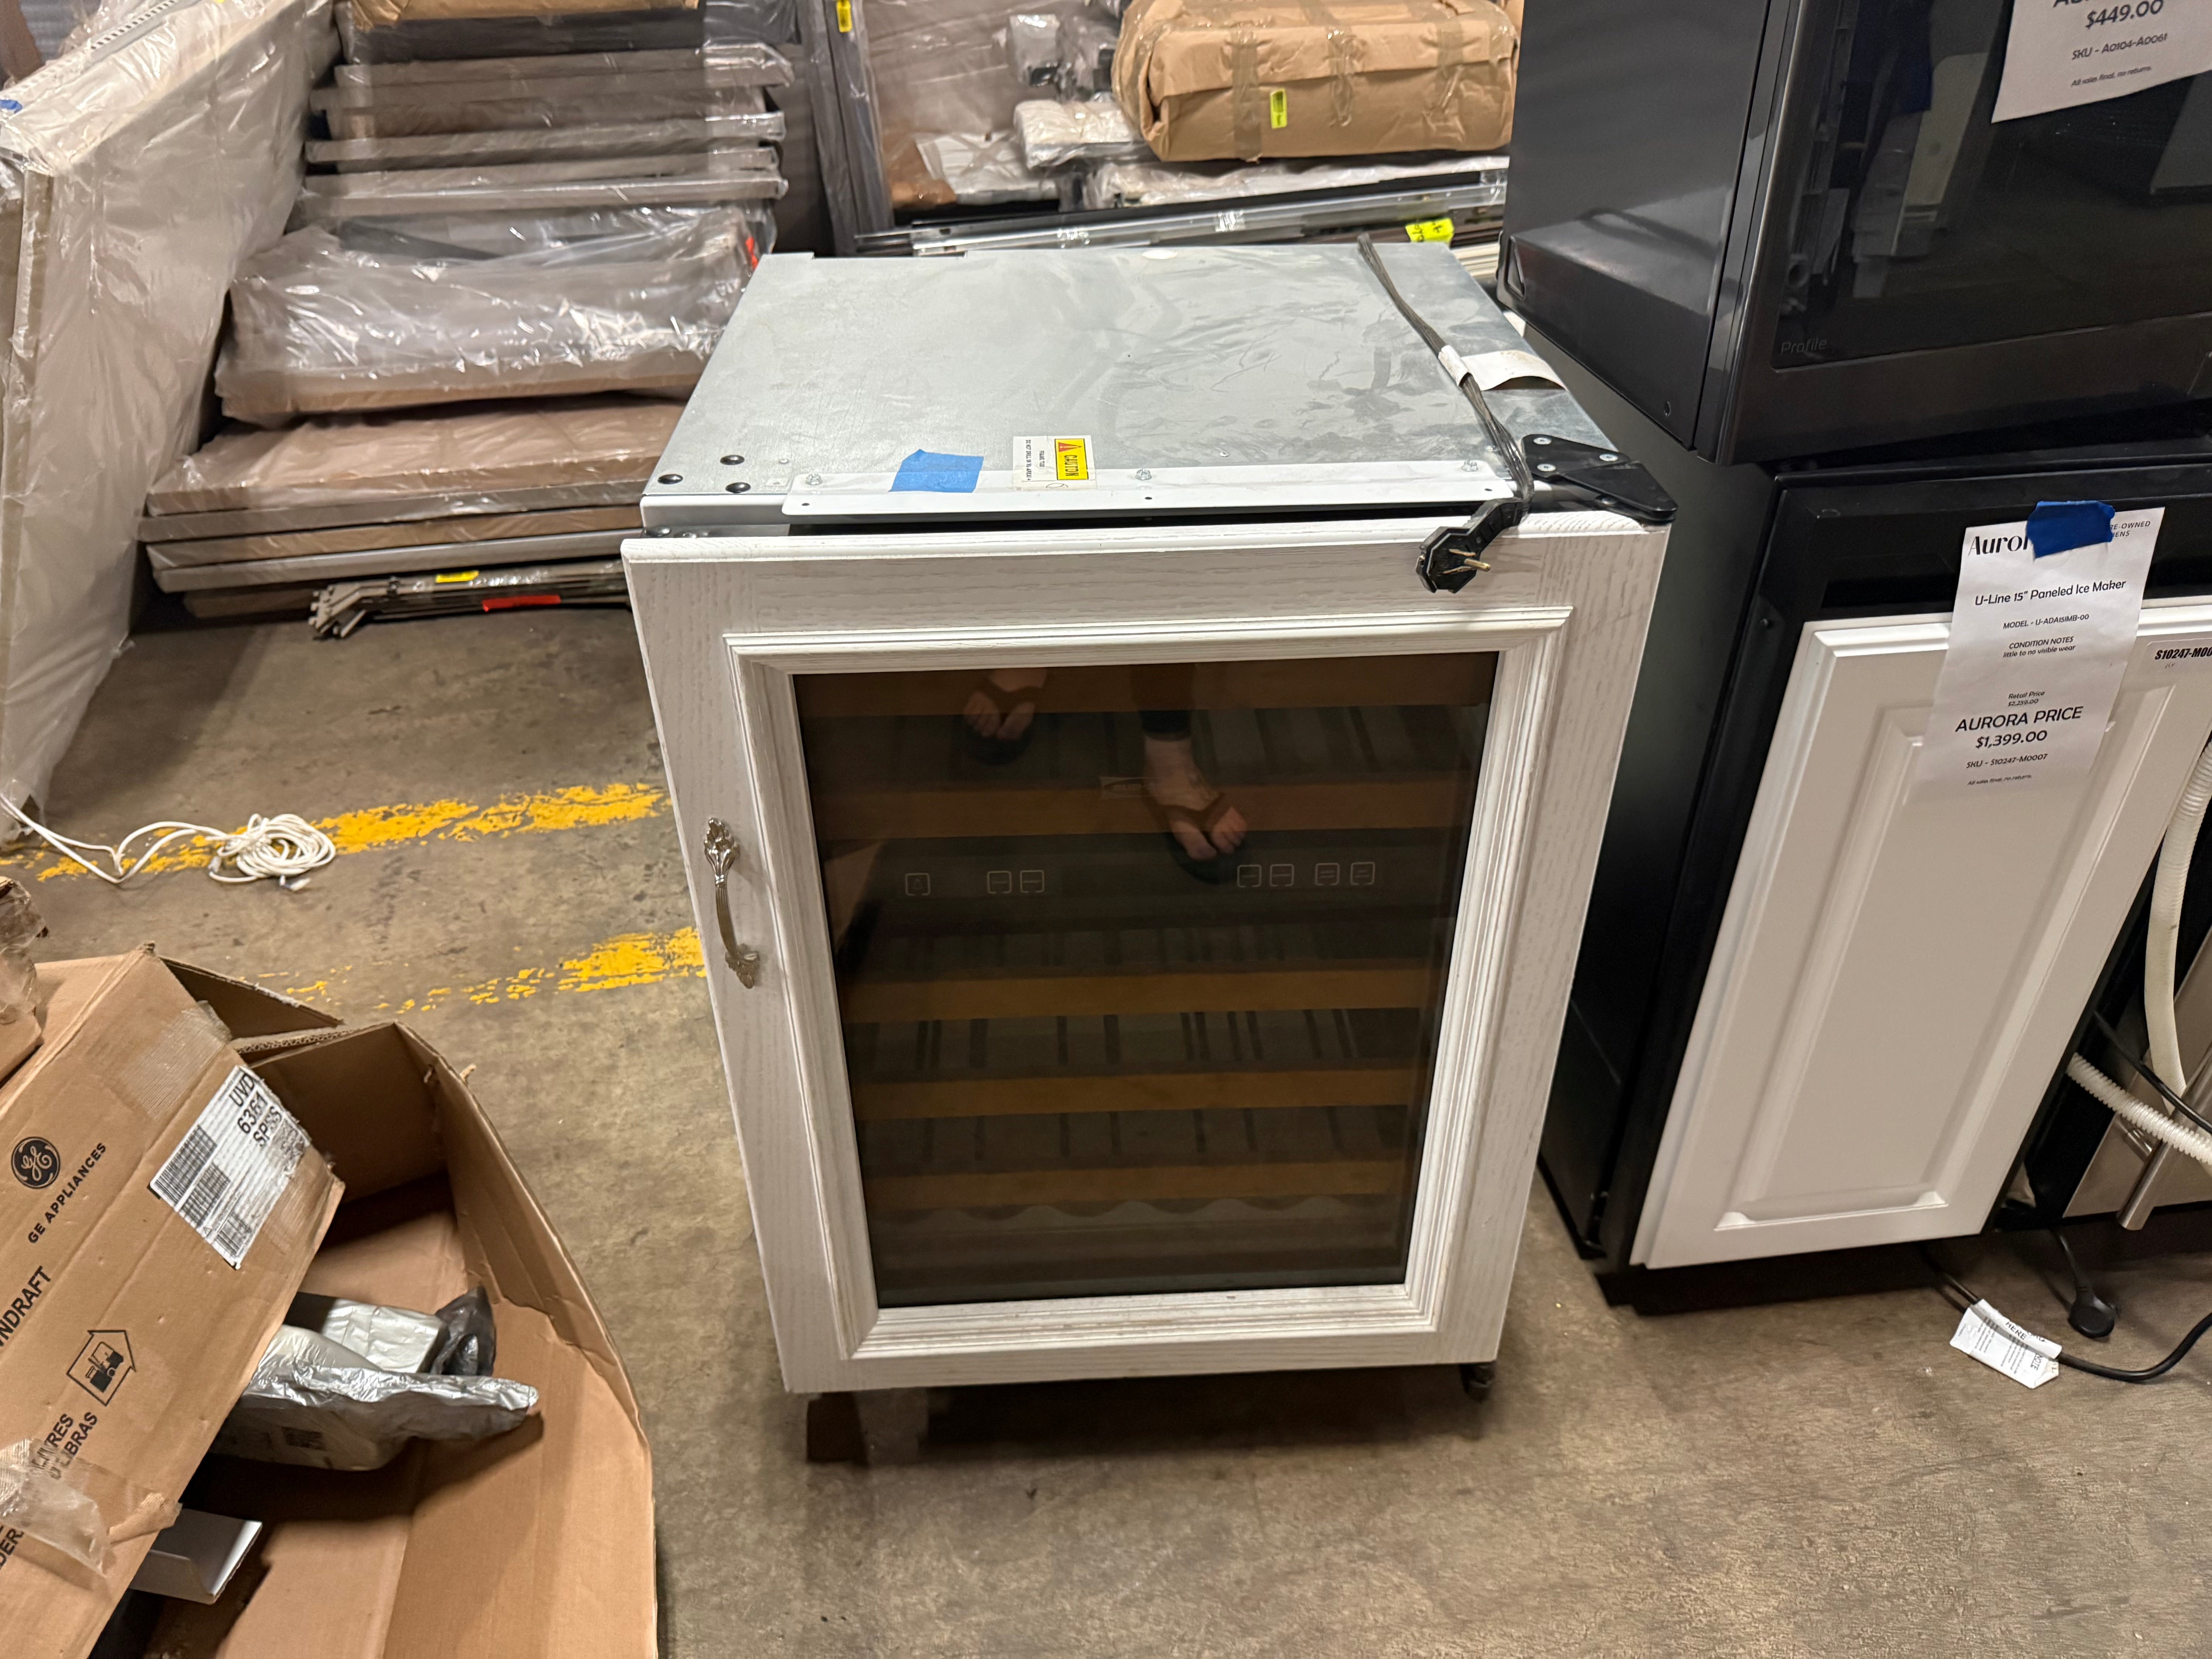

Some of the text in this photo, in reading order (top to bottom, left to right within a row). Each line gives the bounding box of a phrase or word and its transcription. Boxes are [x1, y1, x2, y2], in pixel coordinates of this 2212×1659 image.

[2086, 0, 2164, 29] $449.00
[2072, 47, 2092, 60] SKU
[1781, 338, 1827, 355] Profile
[2109, 520, 2150, 530] RE-OWNED
[1975, 580, 2126, 605] U-Line 15" Paneled Ice Maker
[2003, 620, 2028, 629] MODEL
[2009, 636, 2074, 649] CONDITION NOTES
[1955, 706, 2083, 732] AURORA PRICE
[1975, 730, 2047, 749] $1,399.00
[1966, 760, 1983, 768] SKU
[1990, 754, 2048, 766] S10247-M0007
[229, 1073, 254, 1107] UVD
[28, 1143, 106, 1243] GE APPLIANCES
[0, 1266, 51, 1346] NDRAFT
[2006, 1322, 2027, 1340] HERE
